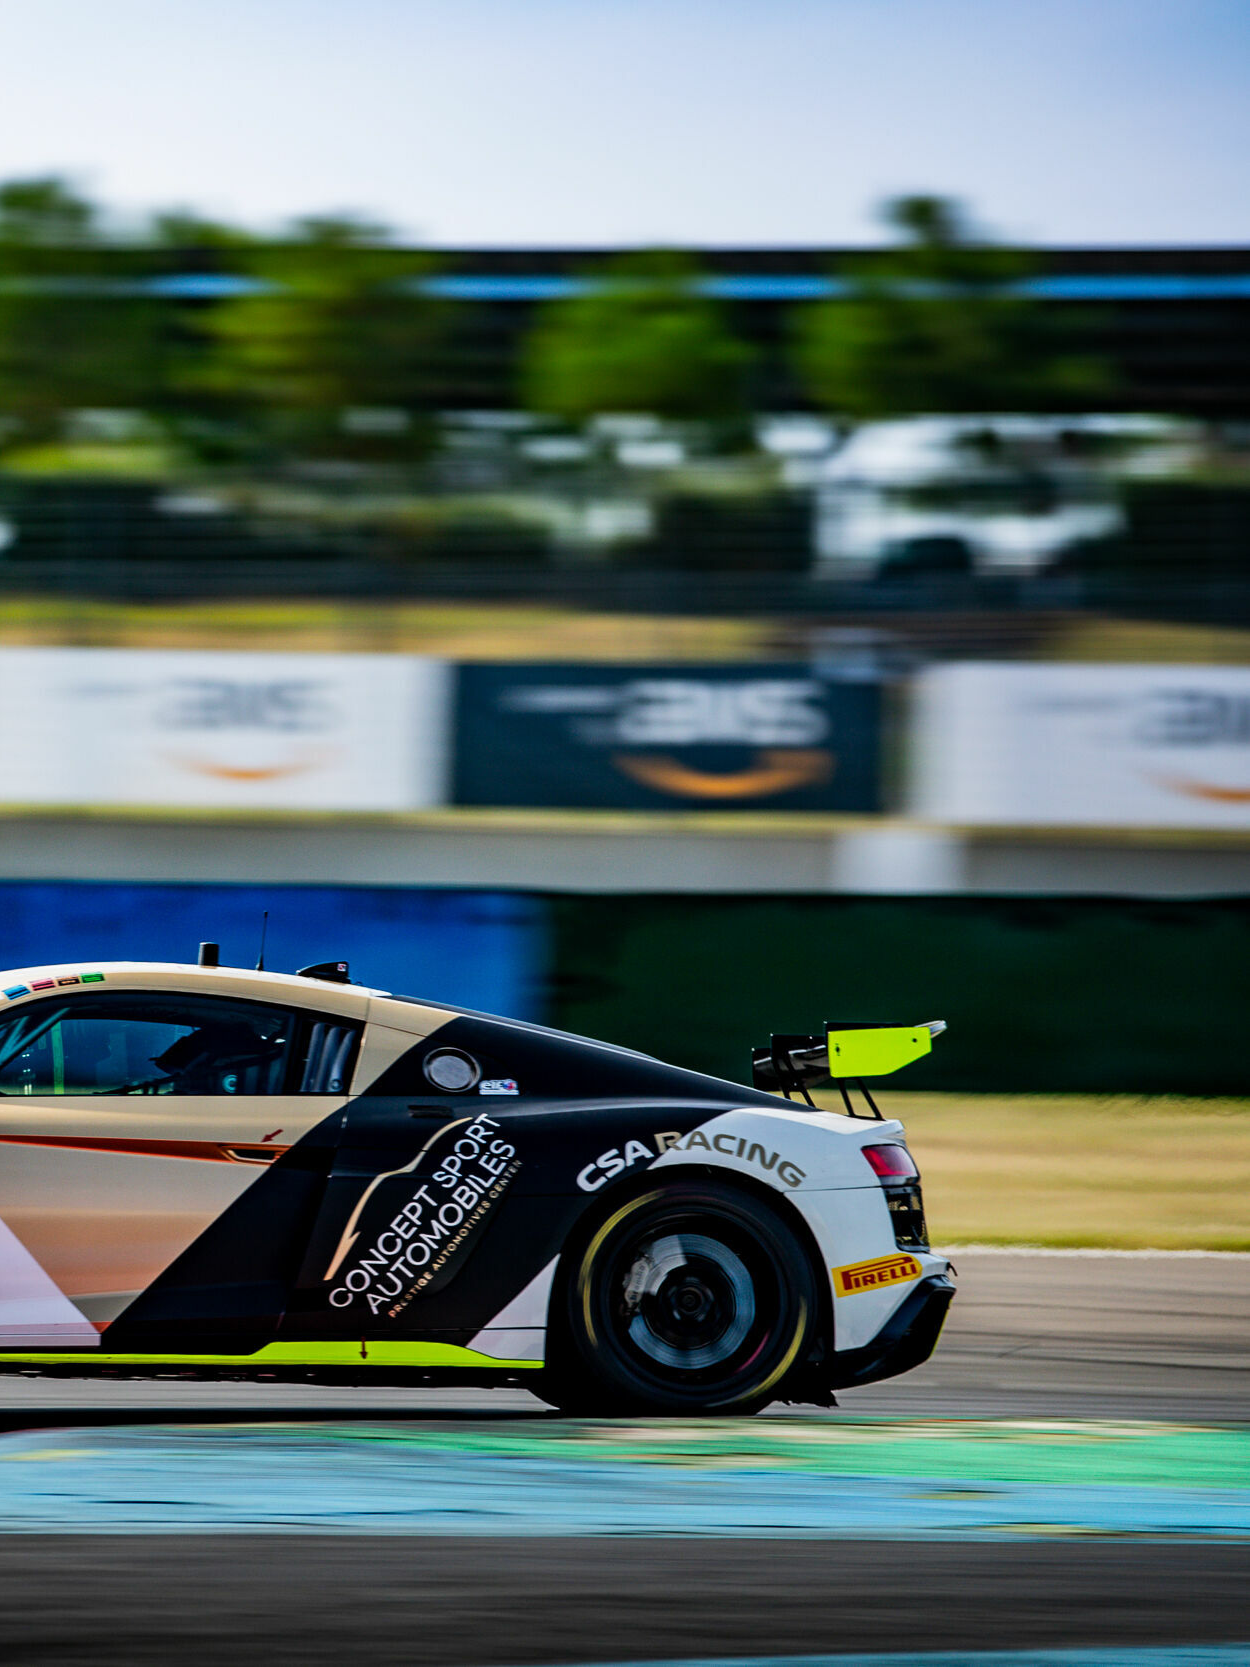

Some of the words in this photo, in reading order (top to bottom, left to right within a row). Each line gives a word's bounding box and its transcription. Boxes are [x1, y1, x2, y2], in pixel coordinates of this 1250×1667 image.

[329, 1185, 438, 1307] CONCEPT
[432, 1113, 501, 1188] SPORT
[576, 1140, 654, 1192] CSA
[654, 1131, 807, 1188] RACING
[366, 1139, 515, 1314] AUTOMOBILES
[388, 1271, 434, 1318] PRESTIGE
[432, 1200, 491, 1271] AUTOMOTIVES
[841, 1256, 918, 1291] PIRELLI
